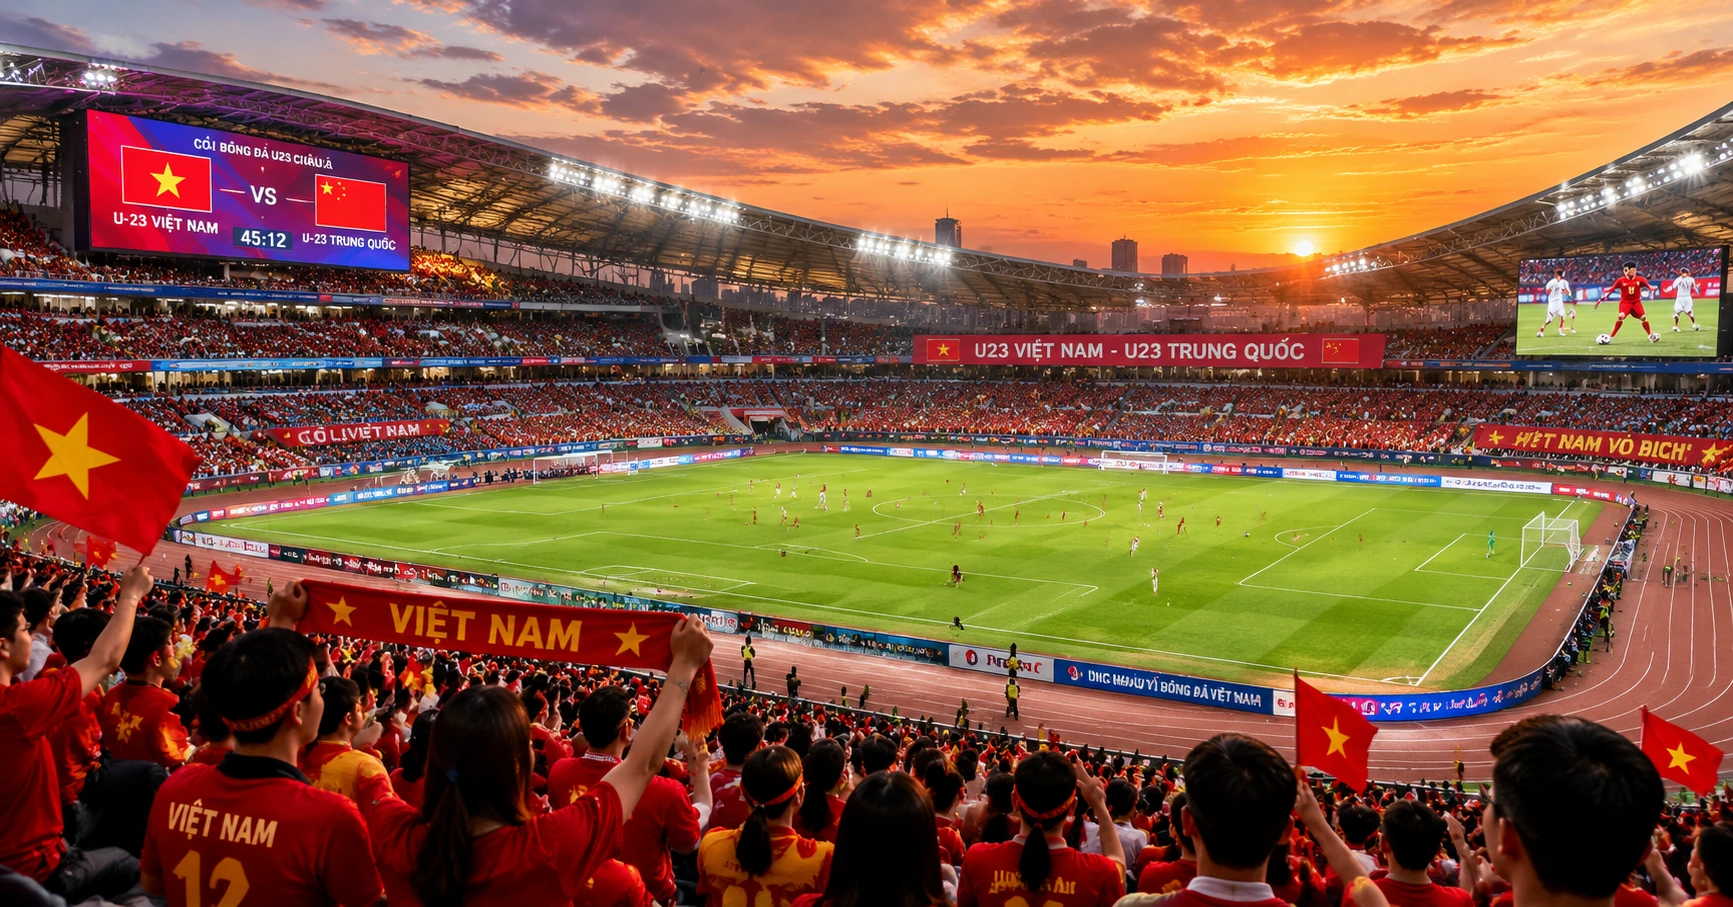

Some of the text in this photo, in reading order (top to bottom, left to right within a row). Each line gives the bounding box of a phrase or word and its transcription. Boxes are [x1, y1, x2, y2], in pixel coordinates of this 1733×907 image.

[250, 185, 277, 206] VS
[113, 212, 219, 235] U-23 VIỆT NAM
[240, 229, 287, 249] 45:12
[302, 233, 396, 251] U-23 TRUNG QUỐC
[974, 343, 1009, 358] U23
[1014, 338, 1054, 362] VIỆT
[1061, 343, 1103, 358] NAM
[1124, 343, 1162, 359] U23
[1167, 343, 1237, 360] TRUNG
[1243, 337, 1305, 362] QUỐC
[386, 423, 421, 437] NAM
[1558, 434, 1602, 453] NAM
[388, 600, 583, 652] VIỆT NAM
[168, 798, 278, 848] VIỆT NAM
